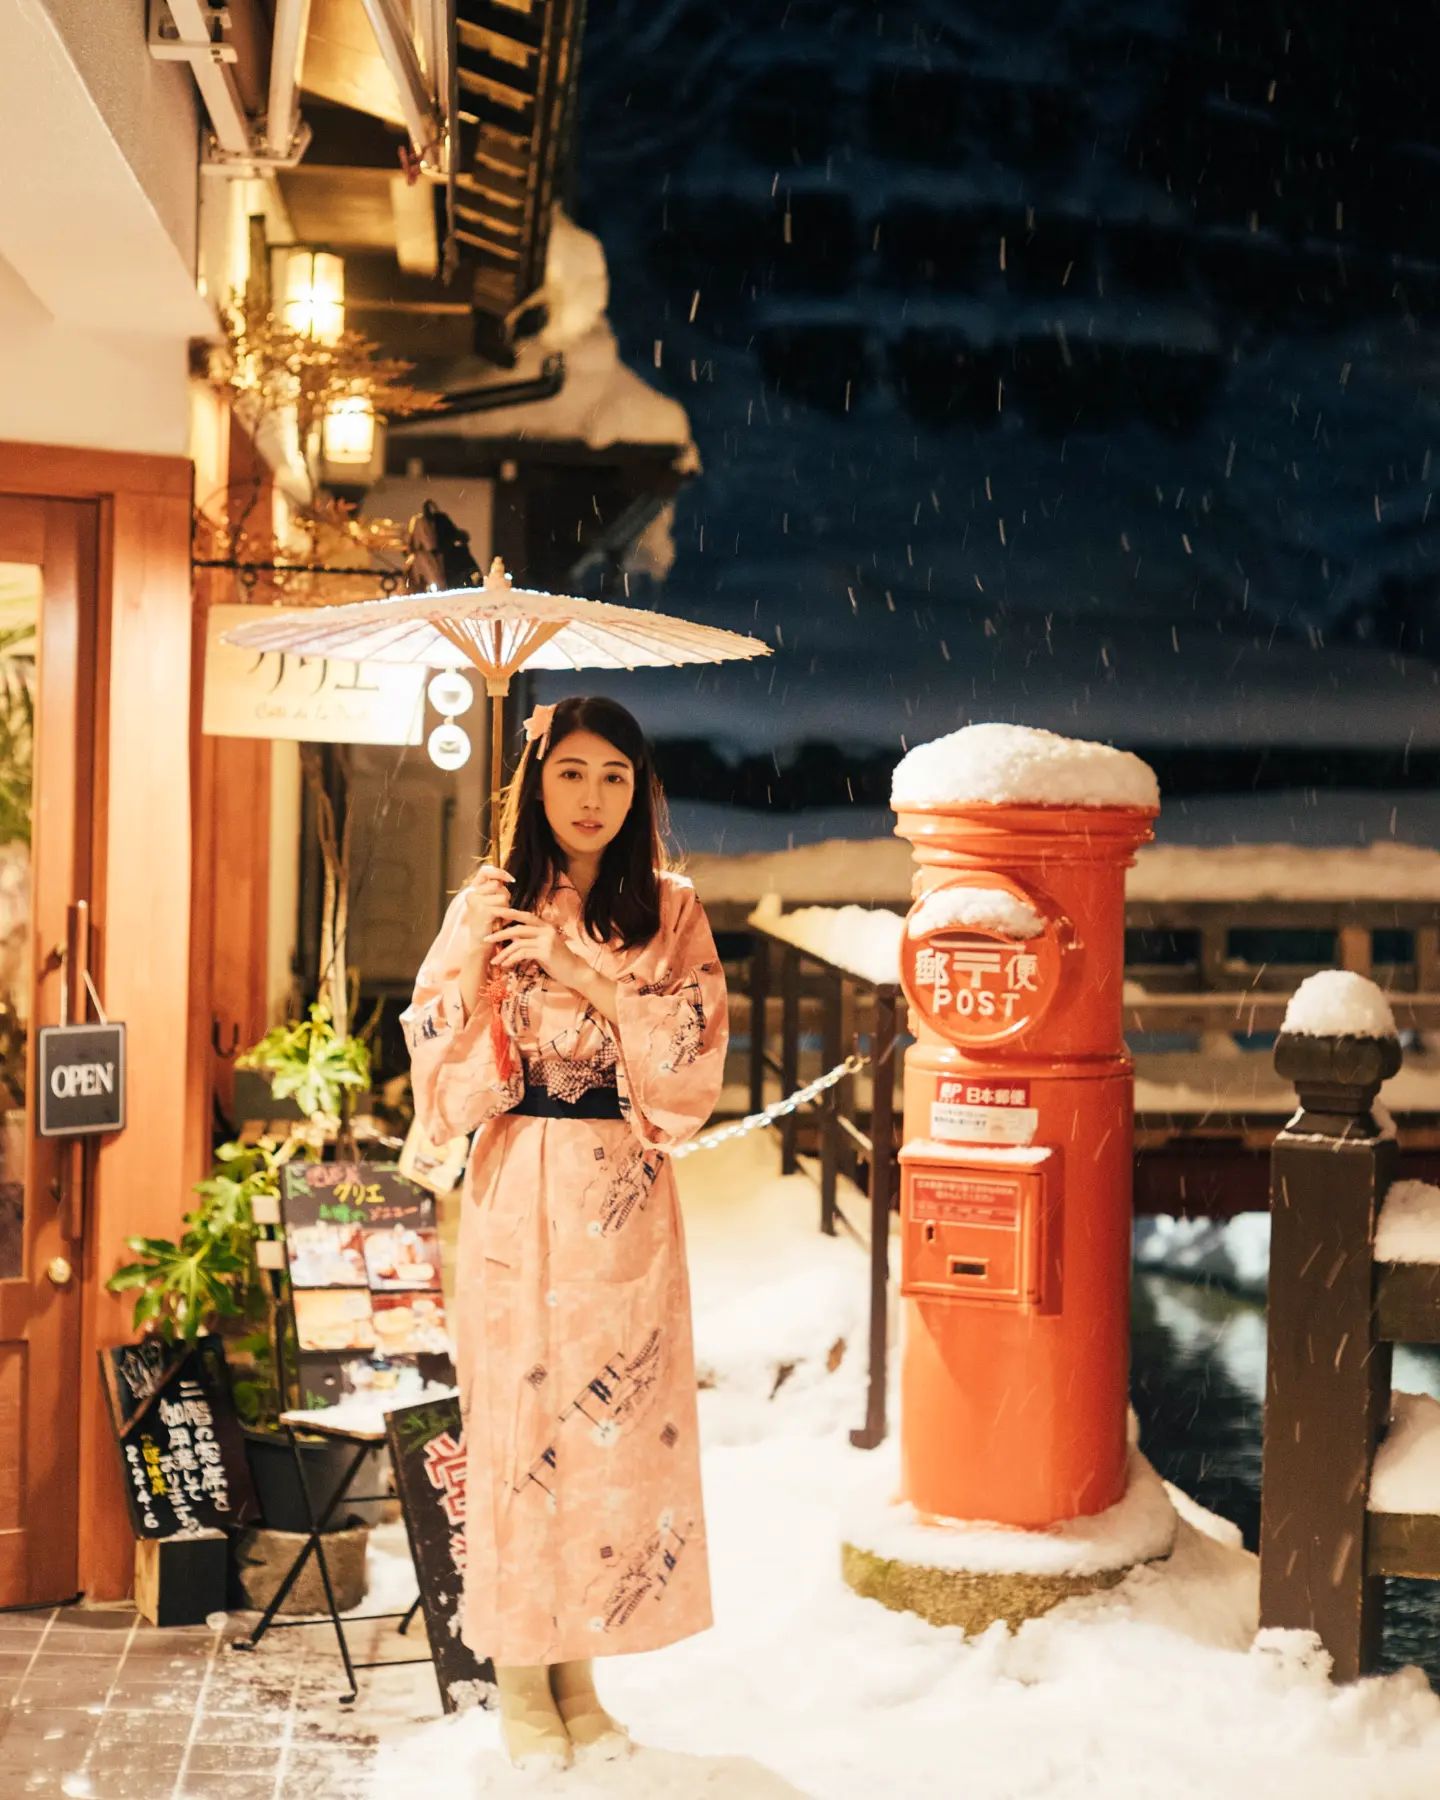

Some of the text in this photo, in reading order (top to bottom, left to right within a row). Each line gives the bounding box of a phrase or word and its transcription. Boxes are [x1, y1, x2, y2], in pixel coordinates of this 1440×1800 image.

[932, 988, 1021, 1018] POST
[50, 1062, 115, 1098] OPEN
[966, 1086, 1026, 1105] 日本郵便
[333, 1183, 385, 1206] クリエ
